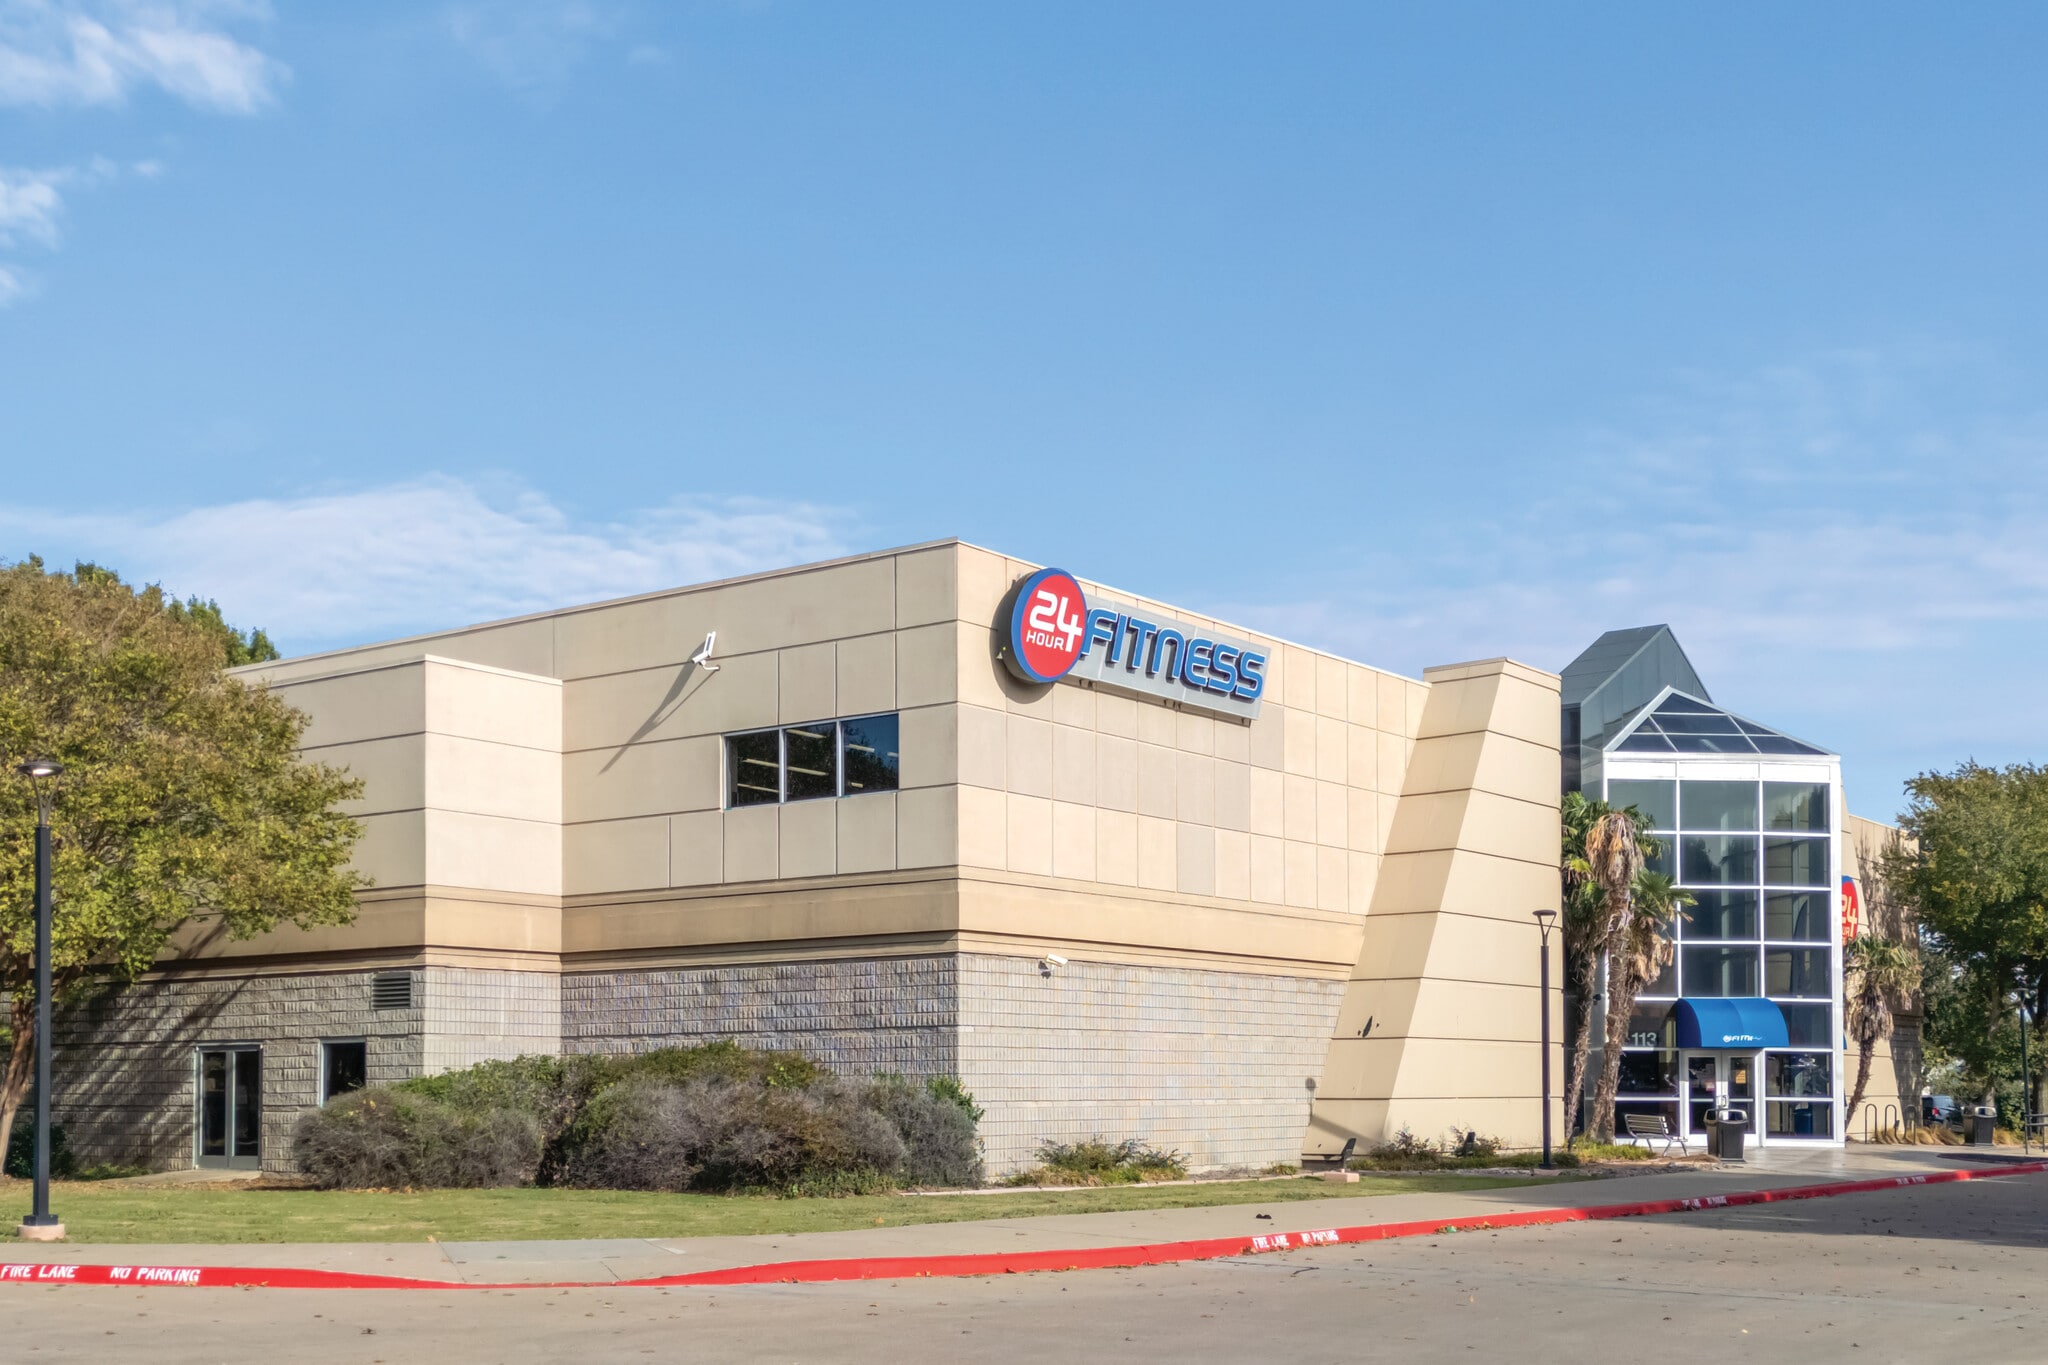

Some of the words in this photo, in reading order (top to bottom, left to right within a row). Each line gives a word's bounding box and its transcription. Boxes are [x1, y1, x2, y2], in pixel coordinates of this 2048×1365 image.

[1029, 590, 1083, 653] 24
[1026, 629, 1064, 651] HOUR
[1081, 608, 1265, 699] FITNESS
[1631, 1032, 1657, 1047] 113
[0, 1265, 36, 1279] FIRE
[38, 1265, 80, 1278] LANE
[110, 1267, 132, 1280] NO
[136, 1267, 201, 1283] PARKING
